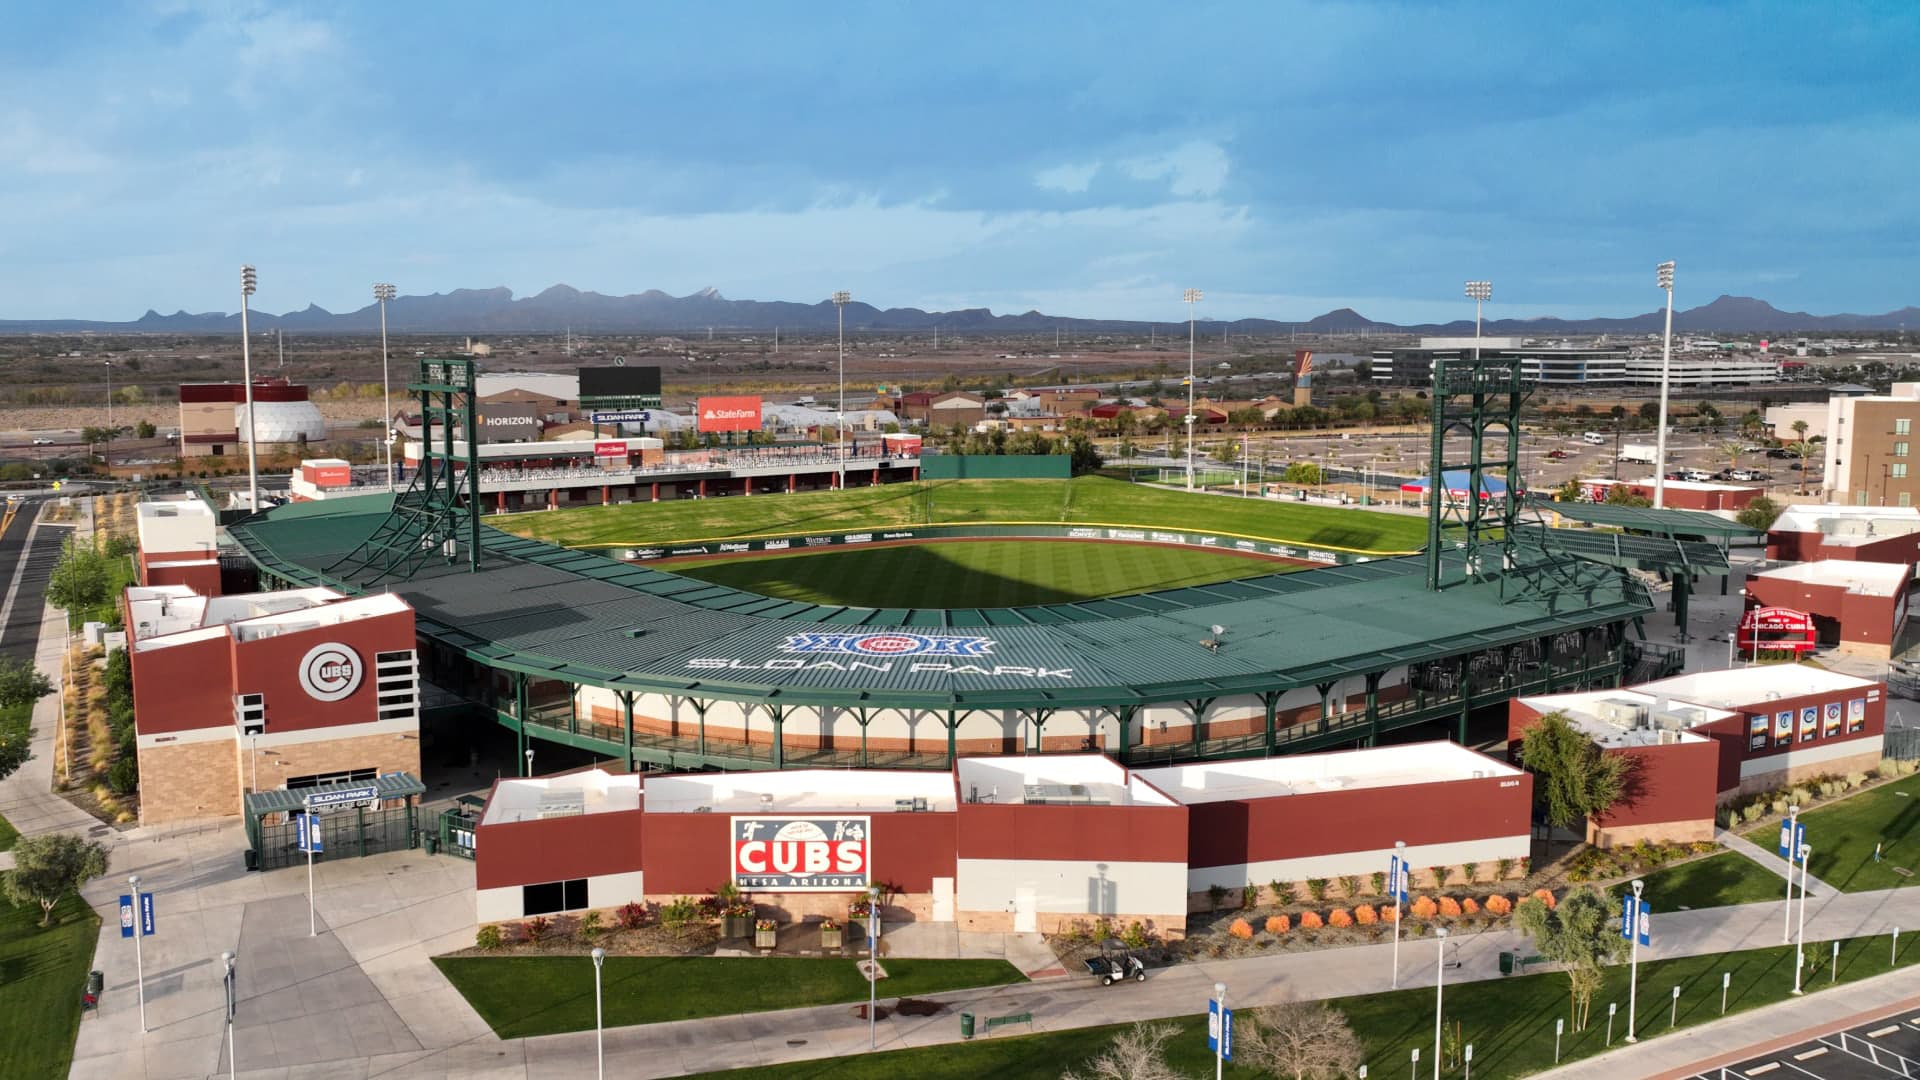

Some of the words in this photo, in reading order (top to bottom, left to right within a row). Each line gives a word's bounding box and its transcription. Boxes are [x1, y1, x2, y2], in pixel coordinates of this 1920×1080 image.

[486, 416, 533, 426] HORIZON
[684, 658, 893, 672] SLOAN
[910, 663, 1073, 679] PARK
[314, 793, 345, 802] SLOAN
[346, 790, 370, 799] PARK
[739, 840, 863, 873] CUBS
[740, 878, 779, 886] MESA
[789, 878, 864, 886] ARIZONA
